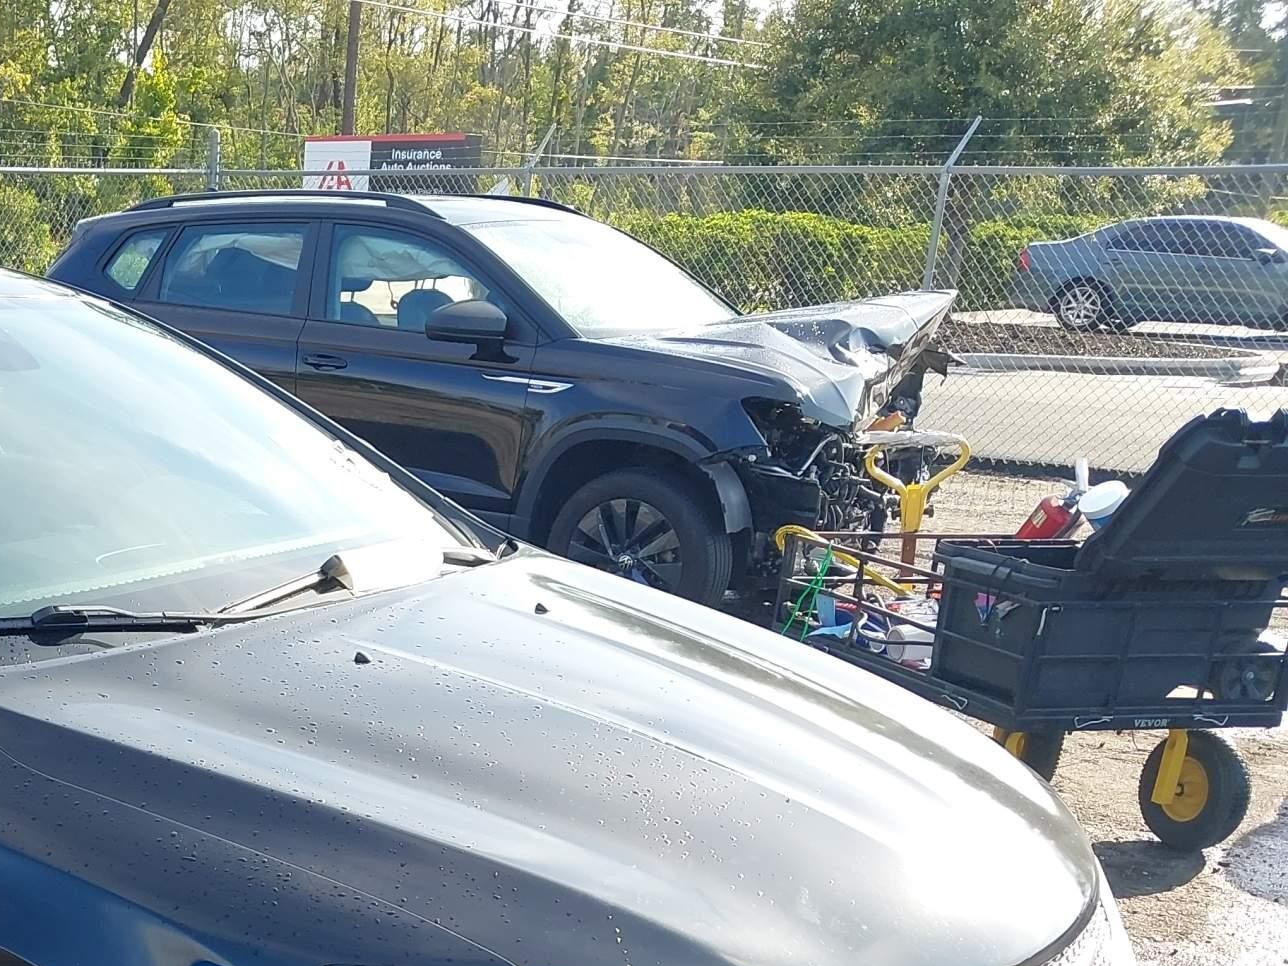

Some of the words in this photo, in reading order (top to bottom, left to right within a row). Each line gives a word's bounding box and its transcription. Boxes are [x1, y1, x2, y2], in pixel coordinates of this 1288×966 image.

[391, 148, 442, 160] Insurance
[380, 161, 404, 171] Auto
[406, 161, 452, 171] Auctions
[1134, 719, 1168, 728] VEVOR
